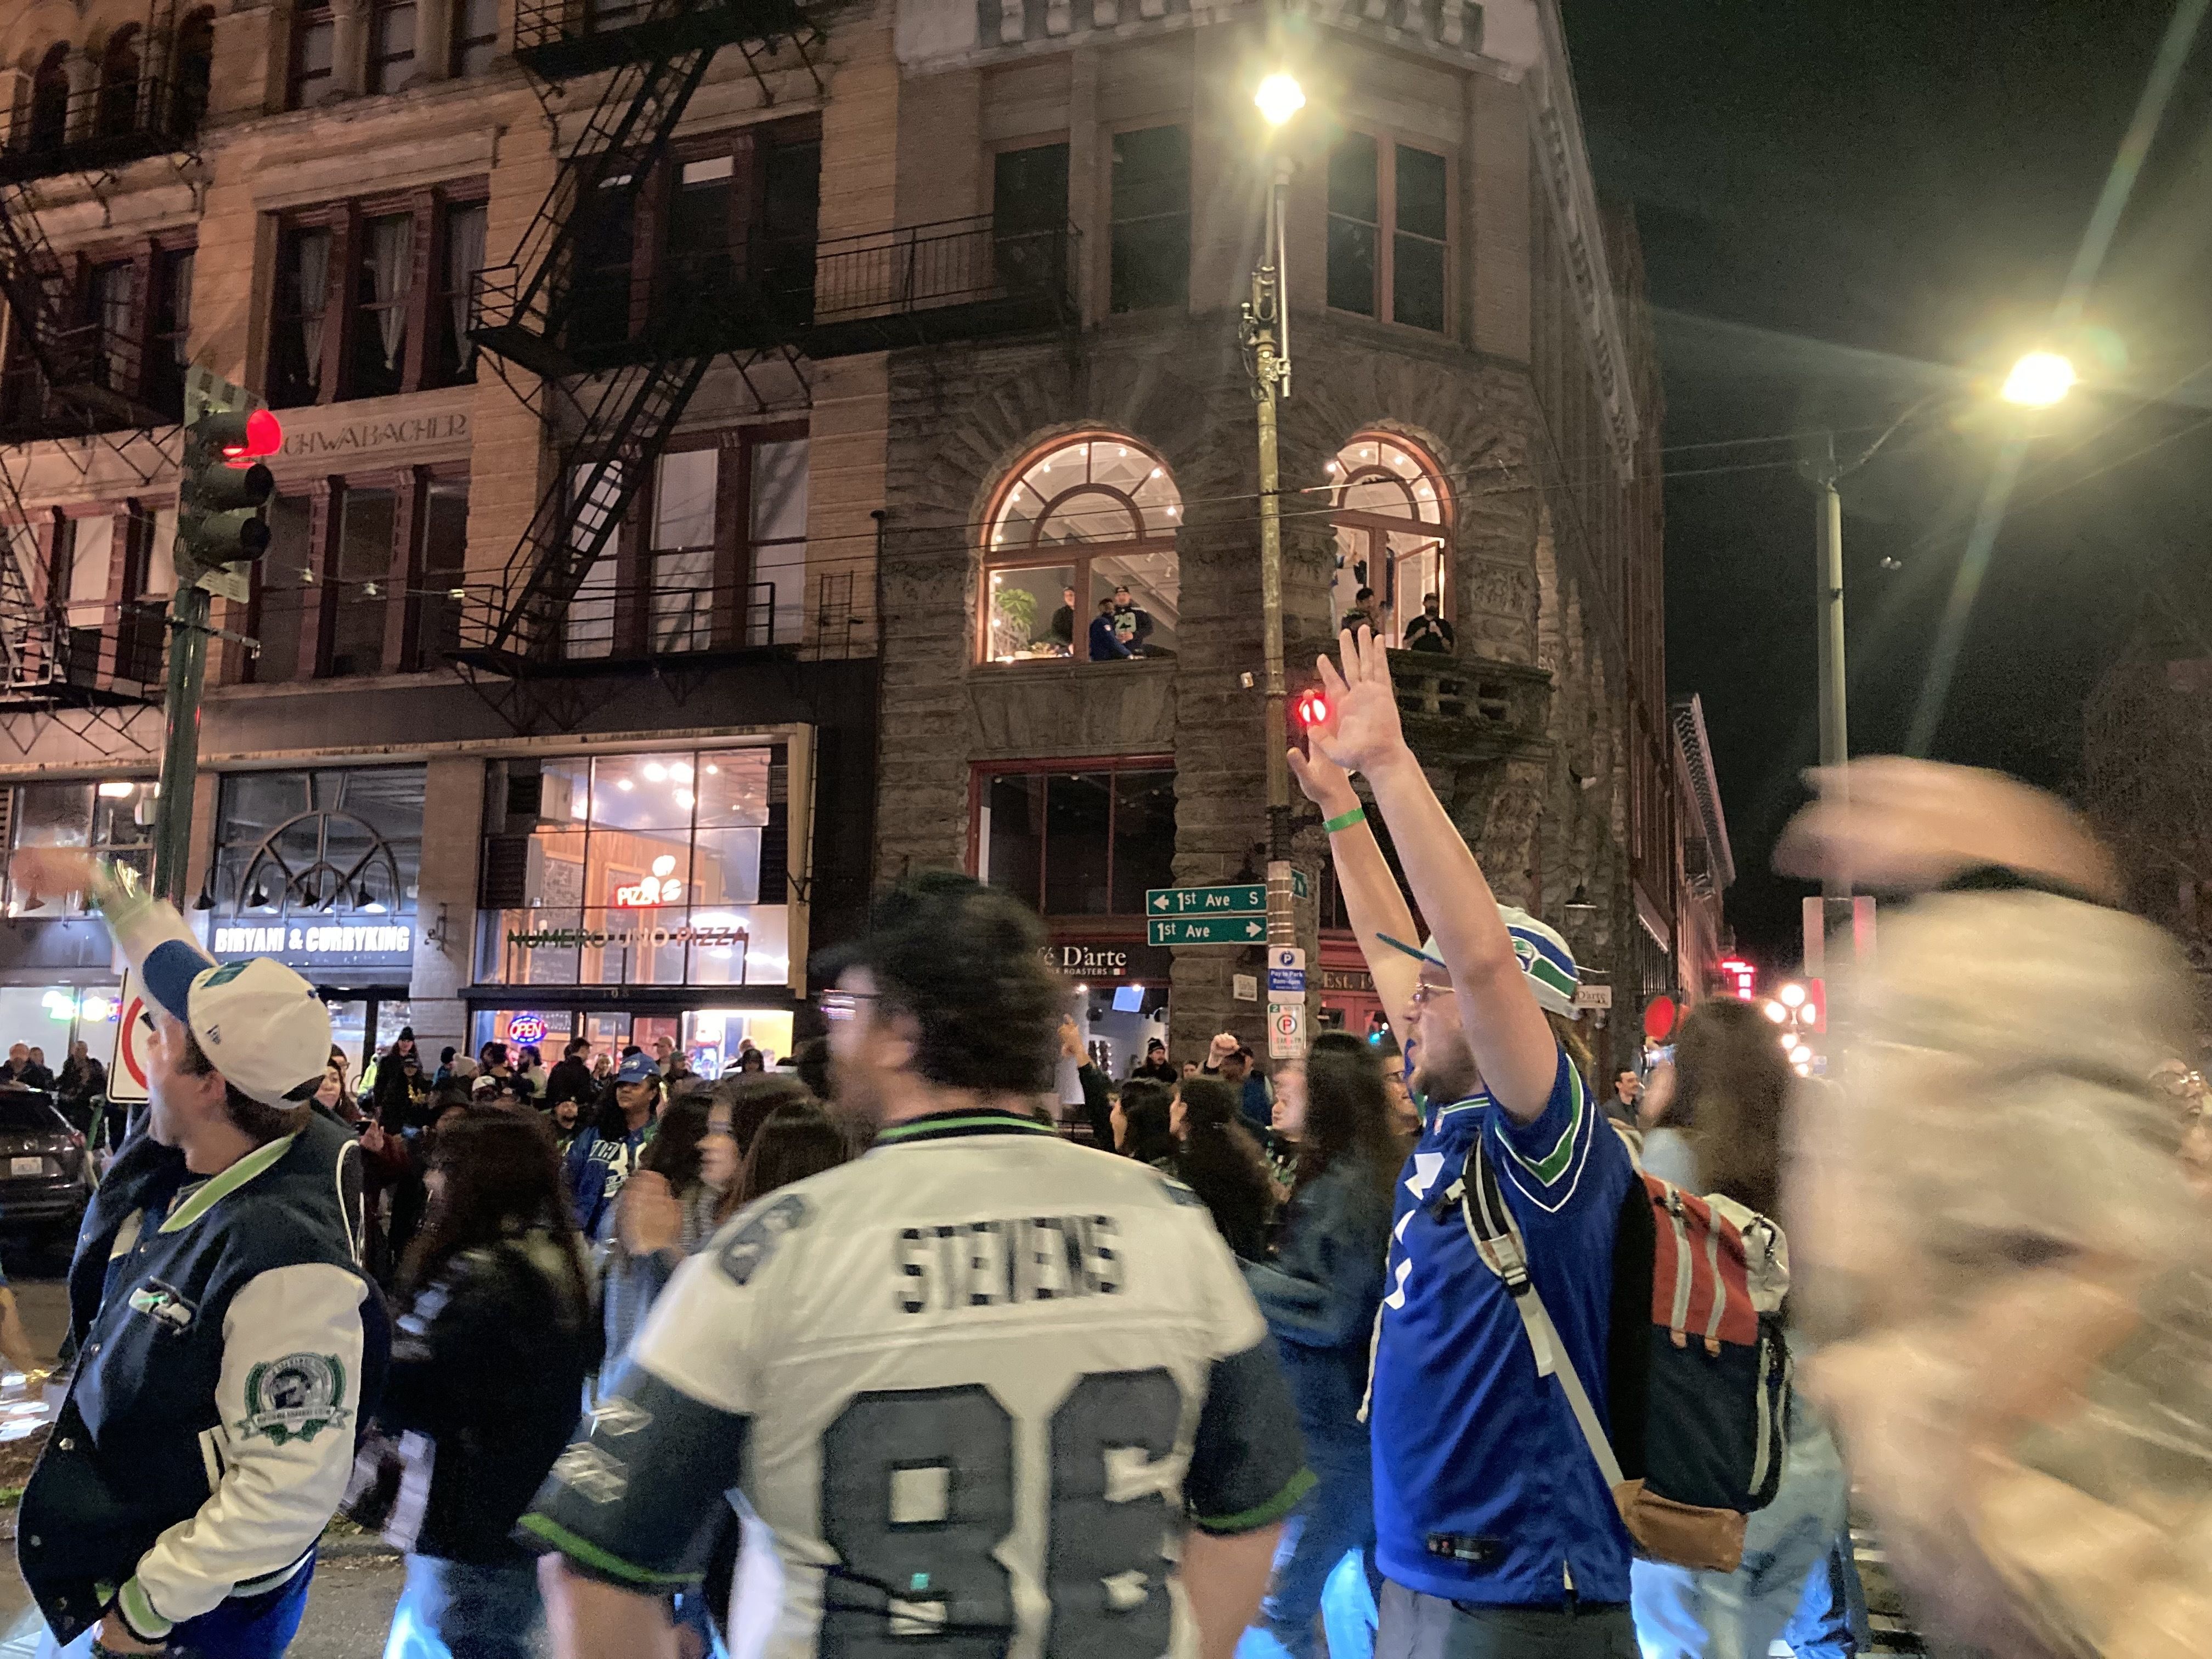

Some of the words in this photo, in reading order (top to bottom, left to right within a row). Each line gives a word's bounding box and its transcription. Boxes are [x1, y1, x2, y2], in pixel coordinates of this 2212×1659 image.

[283, 413, 467, 455] CHWABACHER
[617, 884, 660, 906] PIZZA
[1177, 892, 1197, 911] 1st
[1205, 894, 1230, 906] Ave
[1249, 891, 1259, 905] S
[215, 928, 285, 952] BIRYANI
[289, 928, 303, 950] &
[306, 926, 410, 952] CURRYKING
[506, 927, 608, 949] NUMERO
[615, 927, 670, 949] UNO
[676, 926, 749, 947] PIZZA
[1157, 923, 1176, 941] 1st
[1186, 924, 1210, 938] Ave
[1063, 946, 1127, 966] D'arte
[1324, 972, 1353, 989] Est.
[510, 1021, 543, 1039] OPEN
[896, 1214, 1124, 1313] STEVENS
